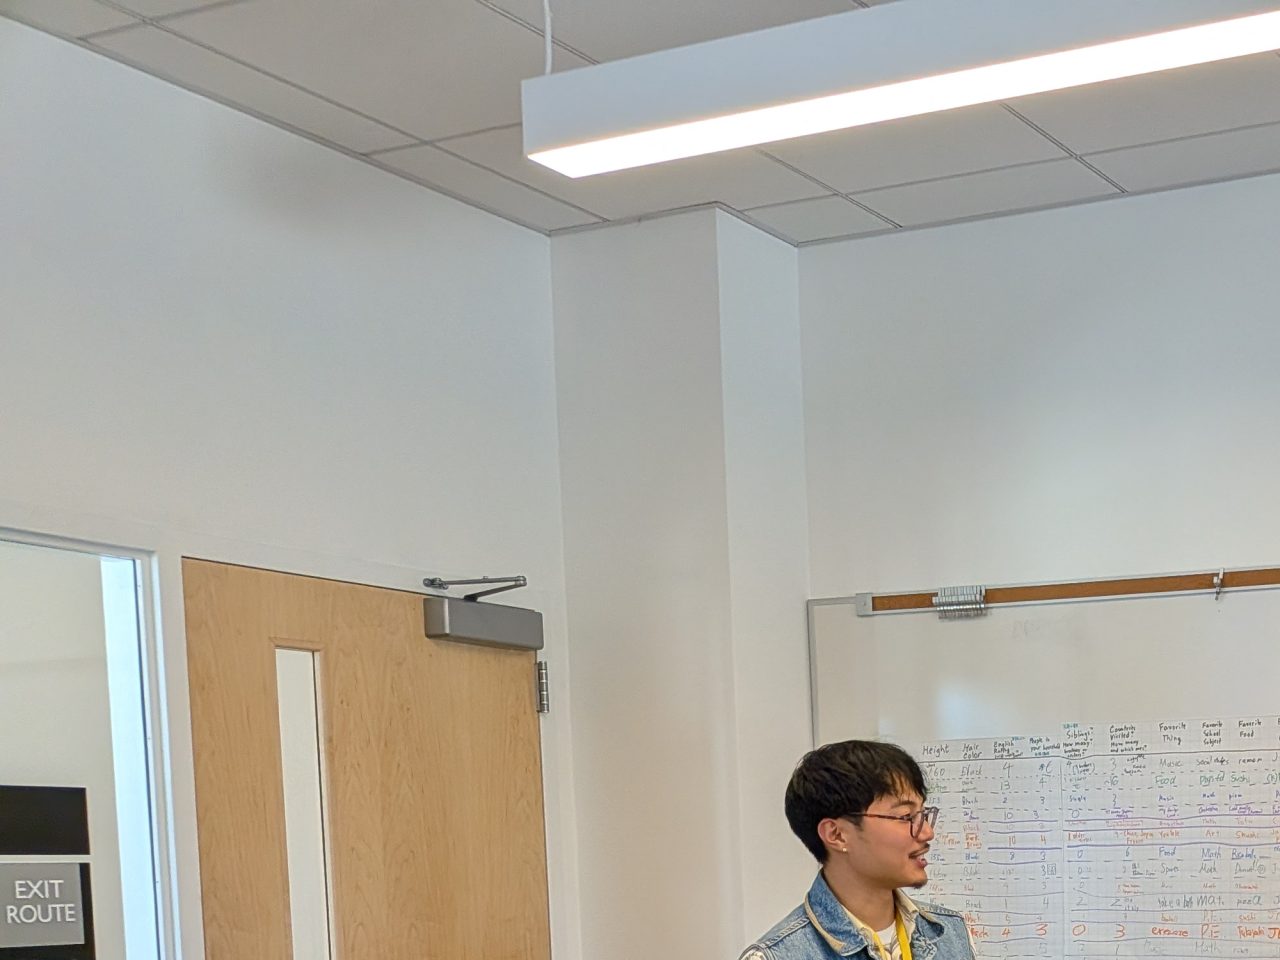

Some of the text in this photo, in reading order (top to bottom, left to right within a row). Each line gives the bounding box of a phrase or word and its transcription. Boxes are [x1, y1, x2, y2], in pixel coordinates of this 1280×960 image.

[1159, 722, 1186, 733] Favorite
[1202, 721, 1223, 729] Favorite
[1238, 719, 1262, 728] Favorite
[1203, 729, 1220, 737] School
[1240, 730, 1254, 738] Food
[1162, 734, 1181, 746] Thing
[1204, 737, 1221, 746] Subject
[923, 744, 950, 756] Height
[962, 743, 979, 752] Hair
[1154, 773, 1176, 785] Food
[1158, 847, 1177, 857] Food
[15, 880, 64, 899] EXIT
[7, 903, 77, 924] ROUTE
[1002, 928, 1011, 937] 4
[1035, 923, 1048, 936] 3
[1072, 923, 1086, 936] 0
[1113, 923, 1125, 938] 3
